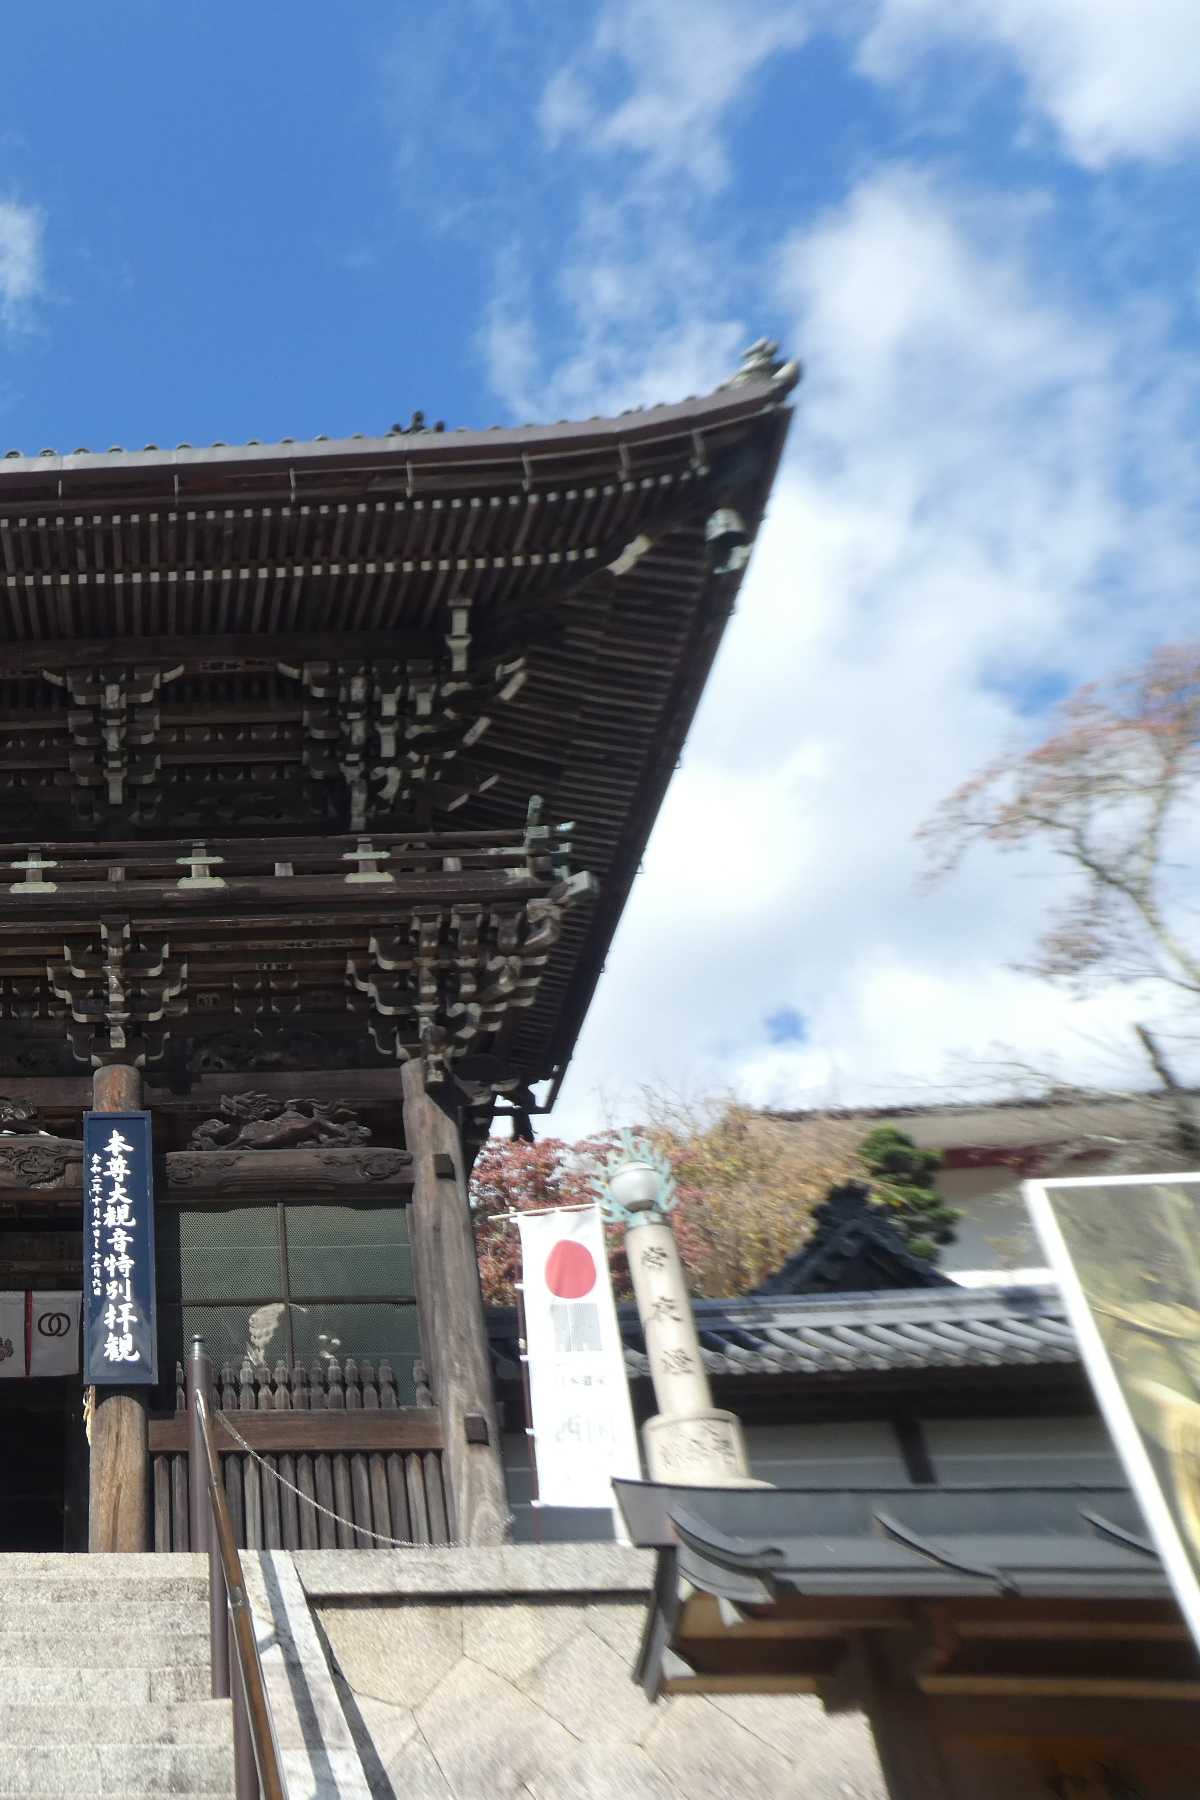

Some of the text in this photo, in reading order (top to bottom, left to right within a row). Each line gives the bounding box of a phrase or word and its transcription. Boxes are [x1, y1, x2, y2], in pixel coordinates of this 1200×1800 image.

[102, 1129, 141, 1362] 本尊大観音特別拝観
